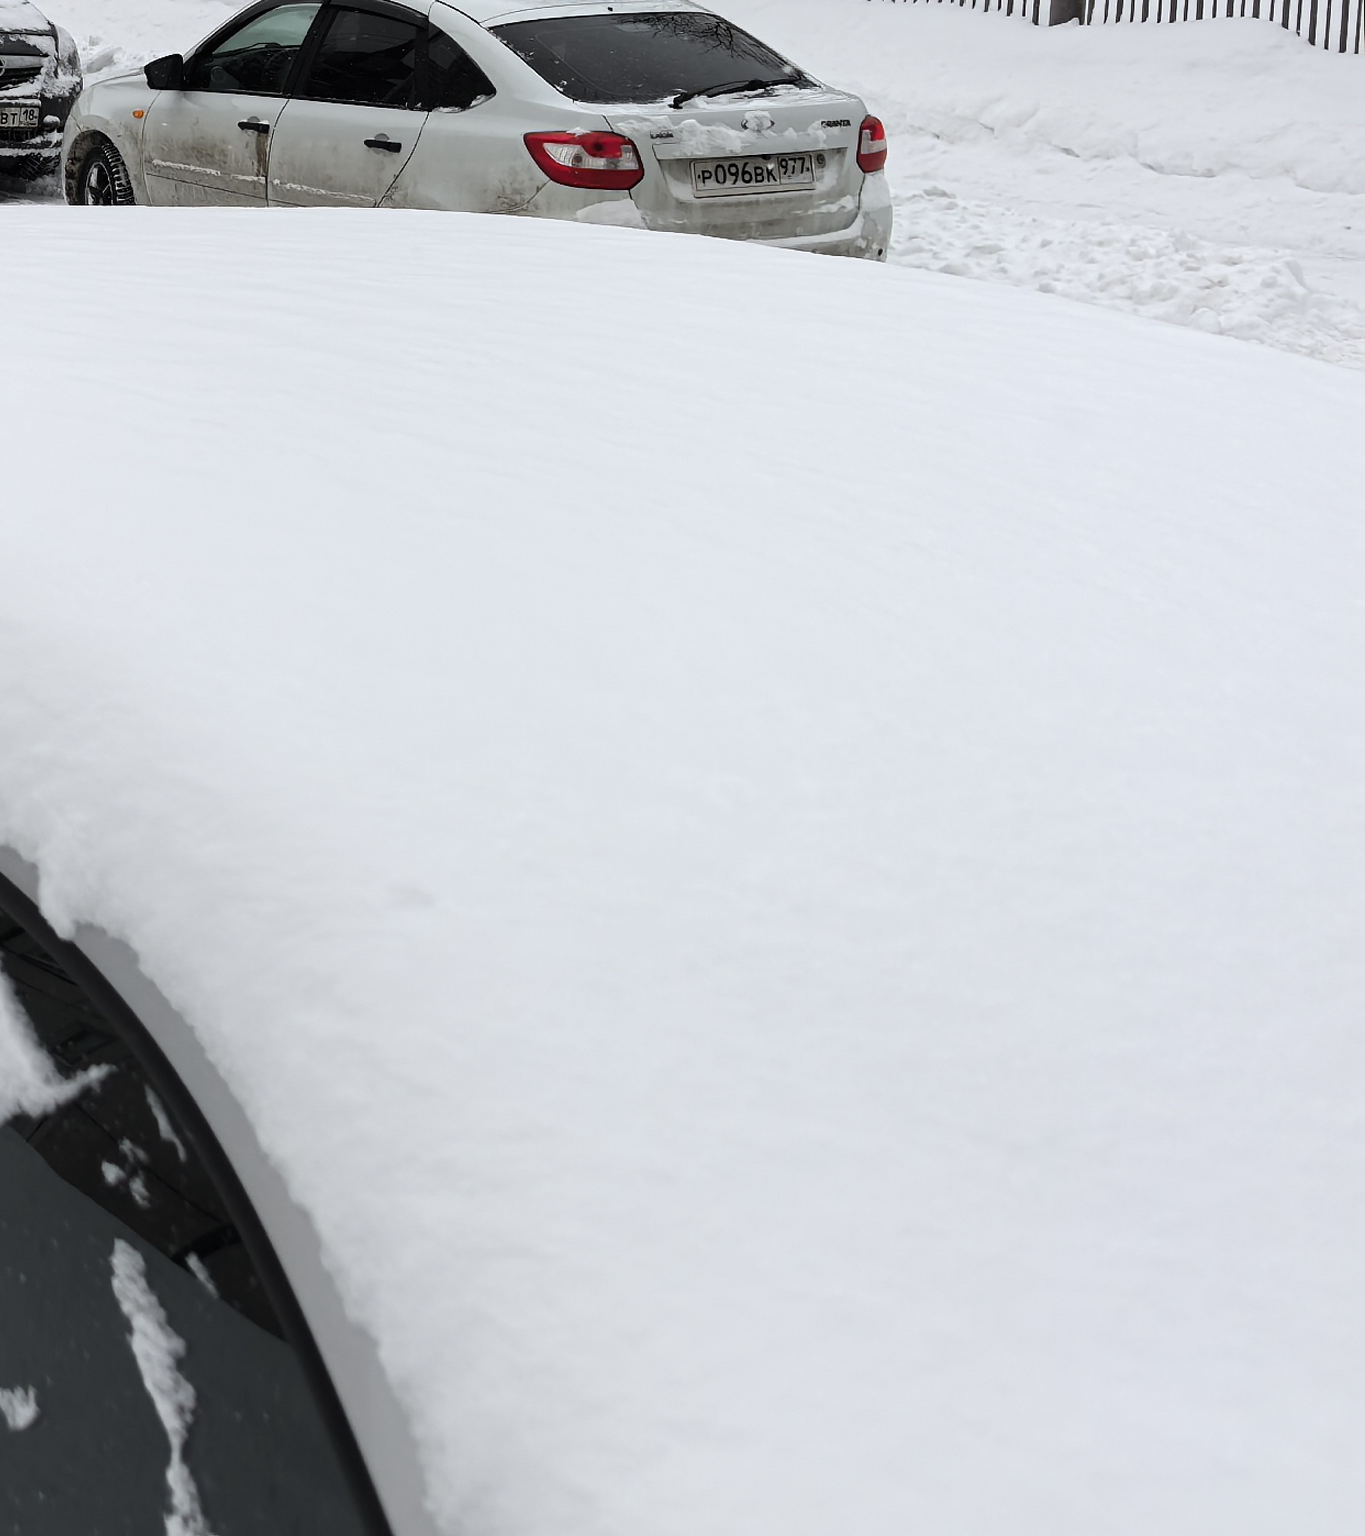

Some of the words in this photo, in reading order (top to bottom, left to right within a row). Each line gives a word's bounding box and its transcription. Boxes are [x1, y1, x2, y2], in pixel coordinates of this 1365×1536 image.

[22, 109, 35, 121] 18
[701, 162, 778, 186] Р096ВК
[779, 156, 806, 176] 977
